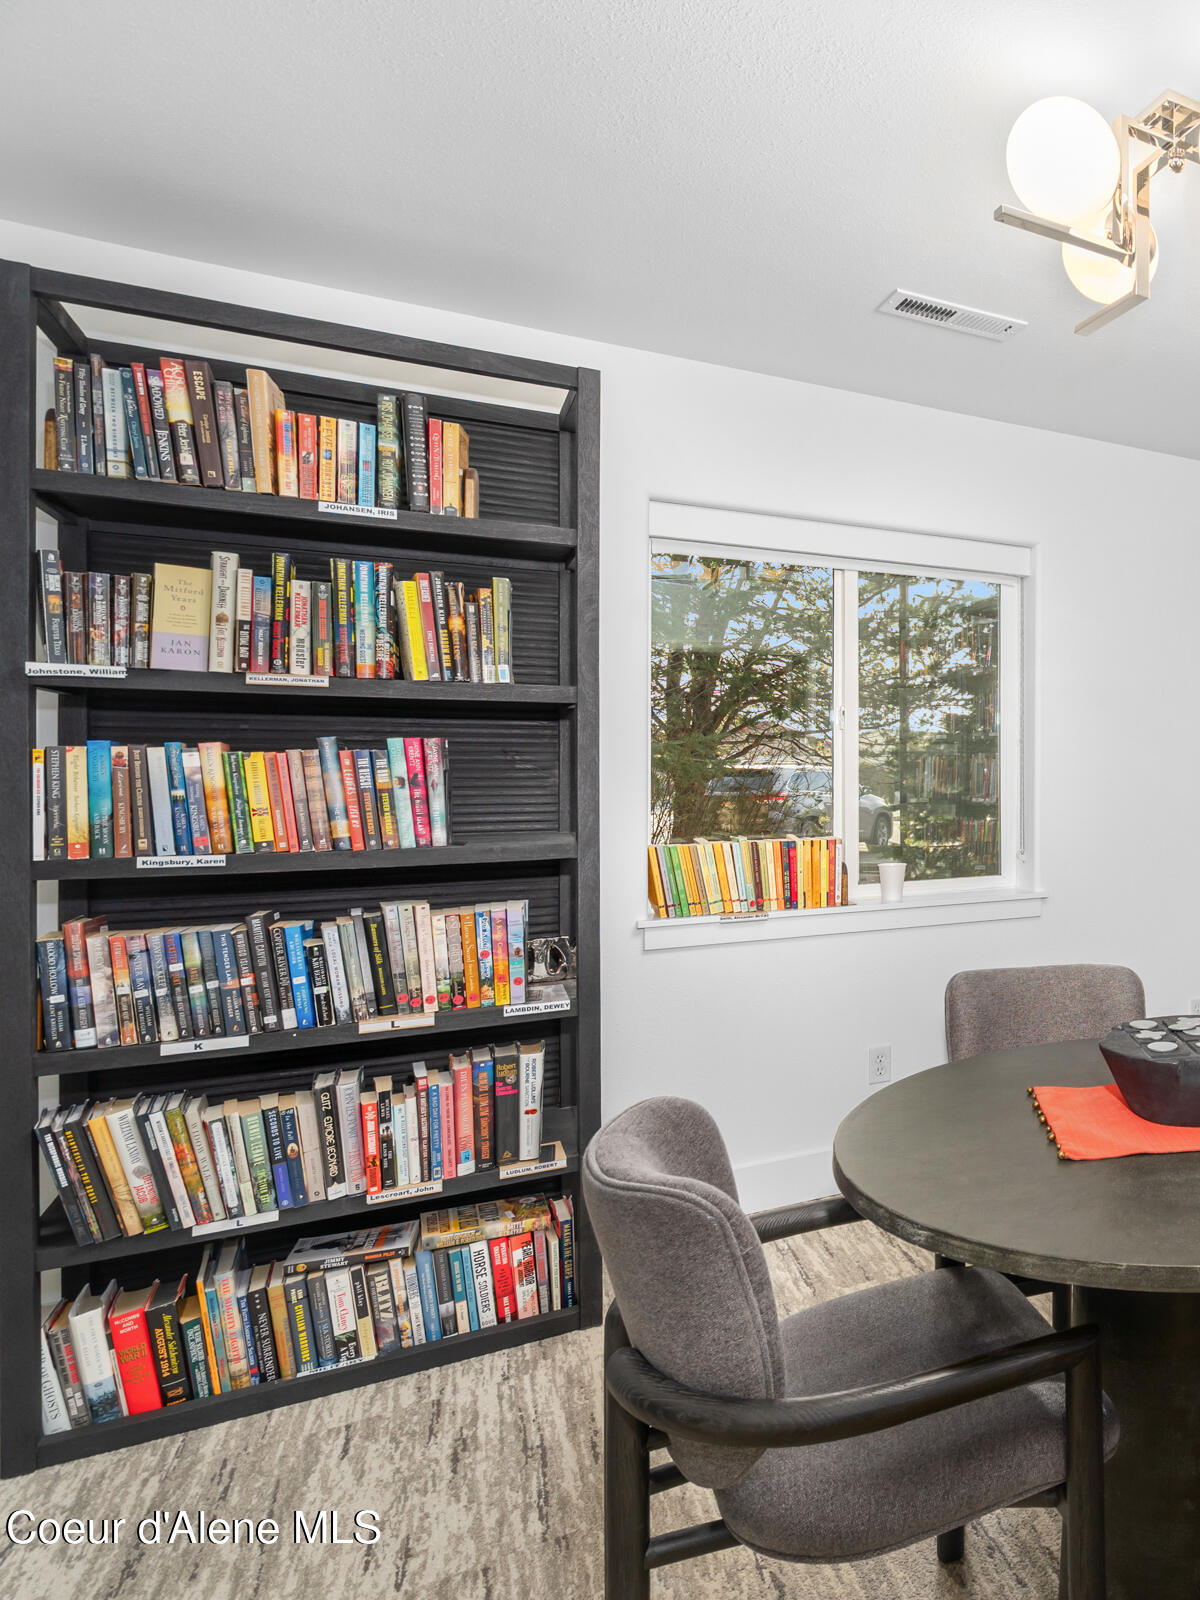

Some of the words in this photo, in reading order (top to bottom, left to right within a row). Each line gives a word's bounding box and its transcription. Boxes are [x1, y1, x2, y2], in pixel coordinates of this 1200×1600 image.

[192, 370, 207, 400] ESCAPE
[324, 504, 375, 515] JOHANSEN,
[378, 509, 395, 517] IRIS
[276, 556, 284, 586] JONATHAN
[337, 562, 346, 590] JONATHAN
[359, 564, 368, 591] JONATHAN
[163, 584, 204, 596] Mitford
[171, 594, 197, 603] Years
[434, 578, 444, 610] JONATHON
[276, 587, 284, 620] KELLERMAN
[338, 591, 347, 625] KELLERMAN
[360, 593, 369, 627] KELLERMAN
[161, 647, 200, 656] KARON
[170, 639, 192, 647] JAN
[339, 628, 348, 663] SERPENTINE
[27, 668, 87, 676] Johnstone,
[51, 750, 60, 780] STEPHEN
[51, 781, 61, 799] KING
[252, 919, 264, 942] MANITOU
[273, 928, 282, 952] COPPER
[47, 942, 55, 965] BLOOD
[255, 943, 267, 967] CANYON
[277, 952, 286, 976] RIVER
[50, 967, 59, 995] HOLLOW
[505, 1006, 542, 1014] LAMBDIN,
[194, 1043, 203, 1051] K
[191, 1122, 203, 1153] WIDOW
[199, 1156, 212, 1182] WALK
[506, 1167, 532, 1176] LUDLUM,
[534, 1162, 558, 1170] ROBERT
[133, 1185, 144, 1204] JACOB
[142, 1173, 159, 1205] DEFENDING
[369, 1189, 413, 1202] Lescroart,
[414, 1184, 435, 1195] John
[324, 1257, 345, 1265] JIMMY
[521, 1240, 532, 1261] PEARL
[320, 1261, 348, 1269] STEWART
[473, 1249, 487, 1280] HORSE
[524, 1261, 535, 1286] HARBOR
[220, 1277, 229, 1293] THE
[374, 1275, 394, 1319] BLITZ
[477, 1280, 491, 1314] SOLDIERS
[223, 1294, 236, 1326] MIGHTY
[337, 1292, 346, 1307] Tom
[339, 1308, 348, 1332] Clancy
[155, 1328, 167, 1357] AUGUST
[228, 1327, 241, 1364] EIGHTH
[257, 1312, 269, 1335] NEVER
[263, 1335, 276, 1380] SURRENDER
[160, 1358, 171, 1378] 1914
[43, 1384, 62, 1421] GHOSTS
